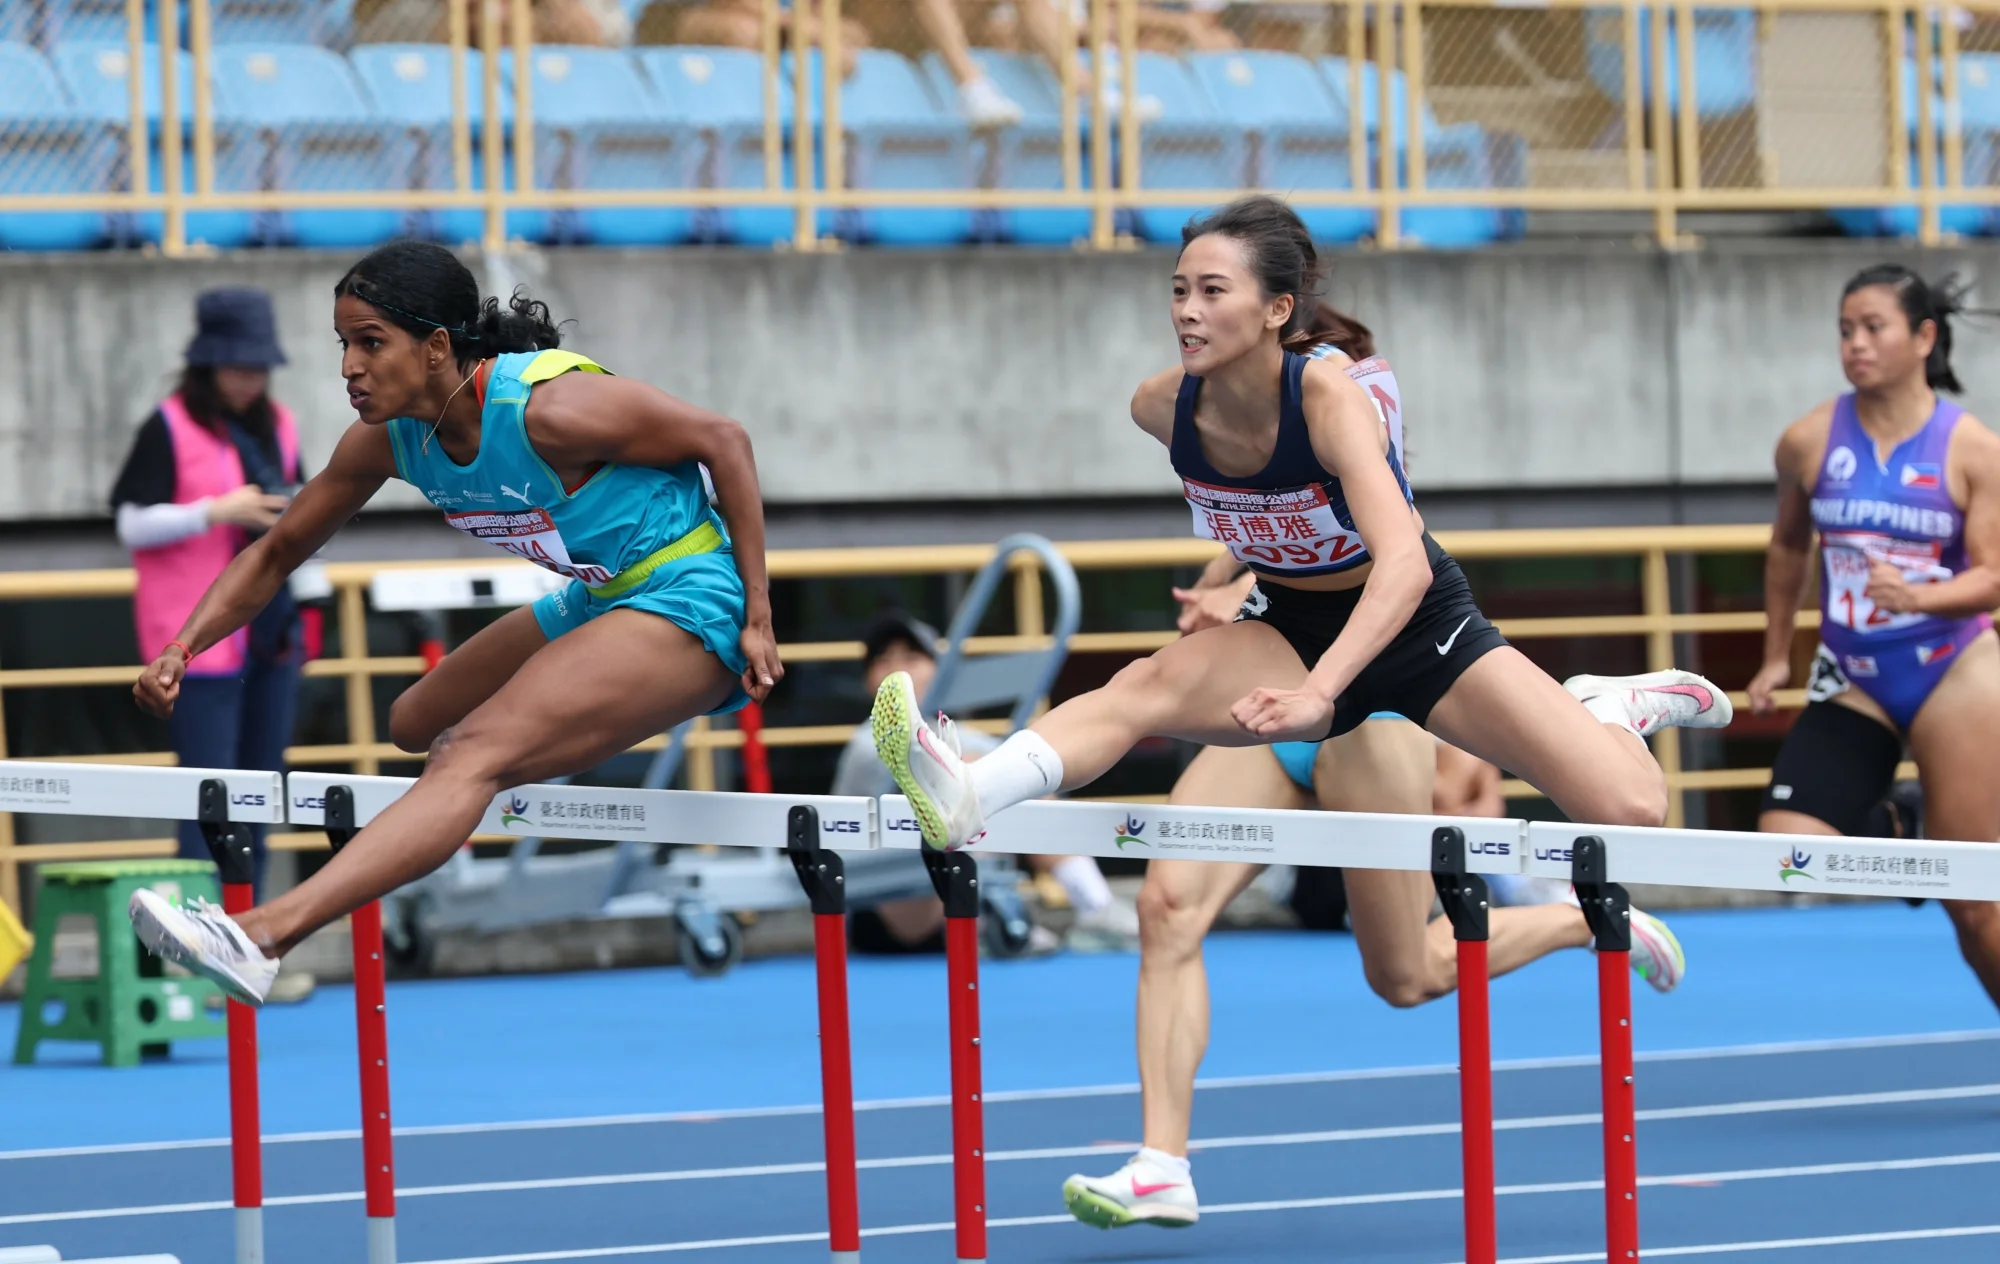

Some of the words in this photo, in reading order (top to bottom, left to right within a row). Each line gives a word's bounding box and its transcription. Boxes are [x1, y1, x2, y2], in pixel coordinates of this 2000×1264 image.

[1219, 503, 1265, 512] ATHLETICS
[1298, 499, 1320, 510] 2024
[1202, 509, 1321, 543] 張博雅
[1810, 498, 1953, 538] PHILIPPINES
[477, 527, 510, 536] ATHLETICS
[511, 526, 531, 535] OPEN
[530, 523, 549, 532] 2024
[490, 539, 554, 562] TYA
[231, 794, 265, 806] UCS
[540, 801, 646, 821] 臺北市政府體育局
[823, 820, 861, 833] UCS
[1157, 821, 1274, 842] 臺北市政府體育局
[1469, 842, 1511, 855] UCS
[1535, 848, 1573, 862] UCS
[1825, 854, 1949, 876] 臺北市政府體育局
